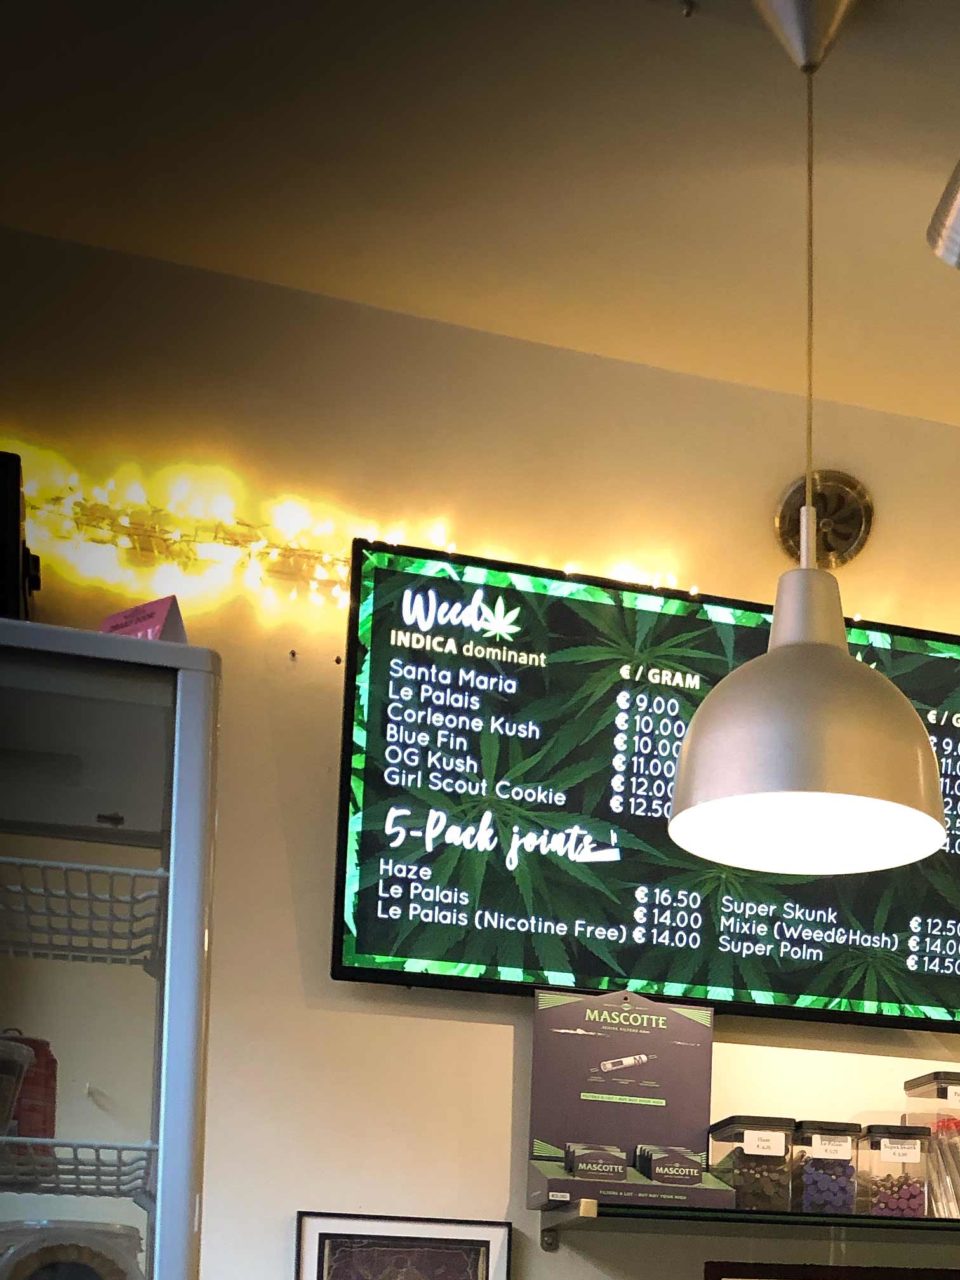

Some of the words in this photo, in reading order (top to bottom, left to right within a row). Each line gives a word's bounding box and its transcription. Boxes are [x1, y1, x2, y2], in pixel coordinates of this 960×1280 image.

[402, 587, 485, 632] Weed
[390, 630, 457, 653] INDICA
[463, 641, 547, 666] dominant
[389, 659, 451, 685] Santa
[459, 668, 517, 694] Maria
[648, 669, 700, 690] GRAM
[388, 682, 413, 701] Le
[420, 686, 481, 710] Palais
[636, 694, 679, 716] 9.00
[387, 705, 483, 732] Corleone
[490, 717, 541, 740] Kush
[634, 715, 686, 737] 10.00
[386, 725, 430, 746] Blue
[437, 732, 468, 751] Fin
[633, 736, 682, 759] 10.00
[385, 747, 418, 765] OG
[427, 752, 479, 773] Kush
[631, 756, 676, 778] 11.00
[383, 768, 422, 788] Girl
[429, 774, 488, 797] Scout
[495, 782, 567, 806] Cookie
[385, 807, 498, 852] 5-Pack
[506, 825, 600, 871] joints
[379, 859, 432, 880] Haze
[378, 883, 403, 898] Le
[410, 883, 469, 905] Palais
[654, 889, 701, 909] 16.50
[653, 909, 702, 929] 14.00
[721, 895, 777, 919] Super
[783, 903, 838, 924] Skunk
[377, 900, 401, 920] Le
[409, 903, 468, 926] Palais
[475, 910, 568, 937] (Nicotine
[575, 920, 627, 944] Free)
[720, 916, 768, 938] Mixie
[773, 921, 899, 951] (Weed&Hash)
[652, 929, 701, 949] 14.00
[718, 936, 774, 958] Super
[780, 941, 823, 962] Polm
[585, 1008, 667, 1029] MASCOTTE
[578, 1162, 624, 1173] MASCOTTE
[655, 1166, 699, 1176] MASCOTTE
